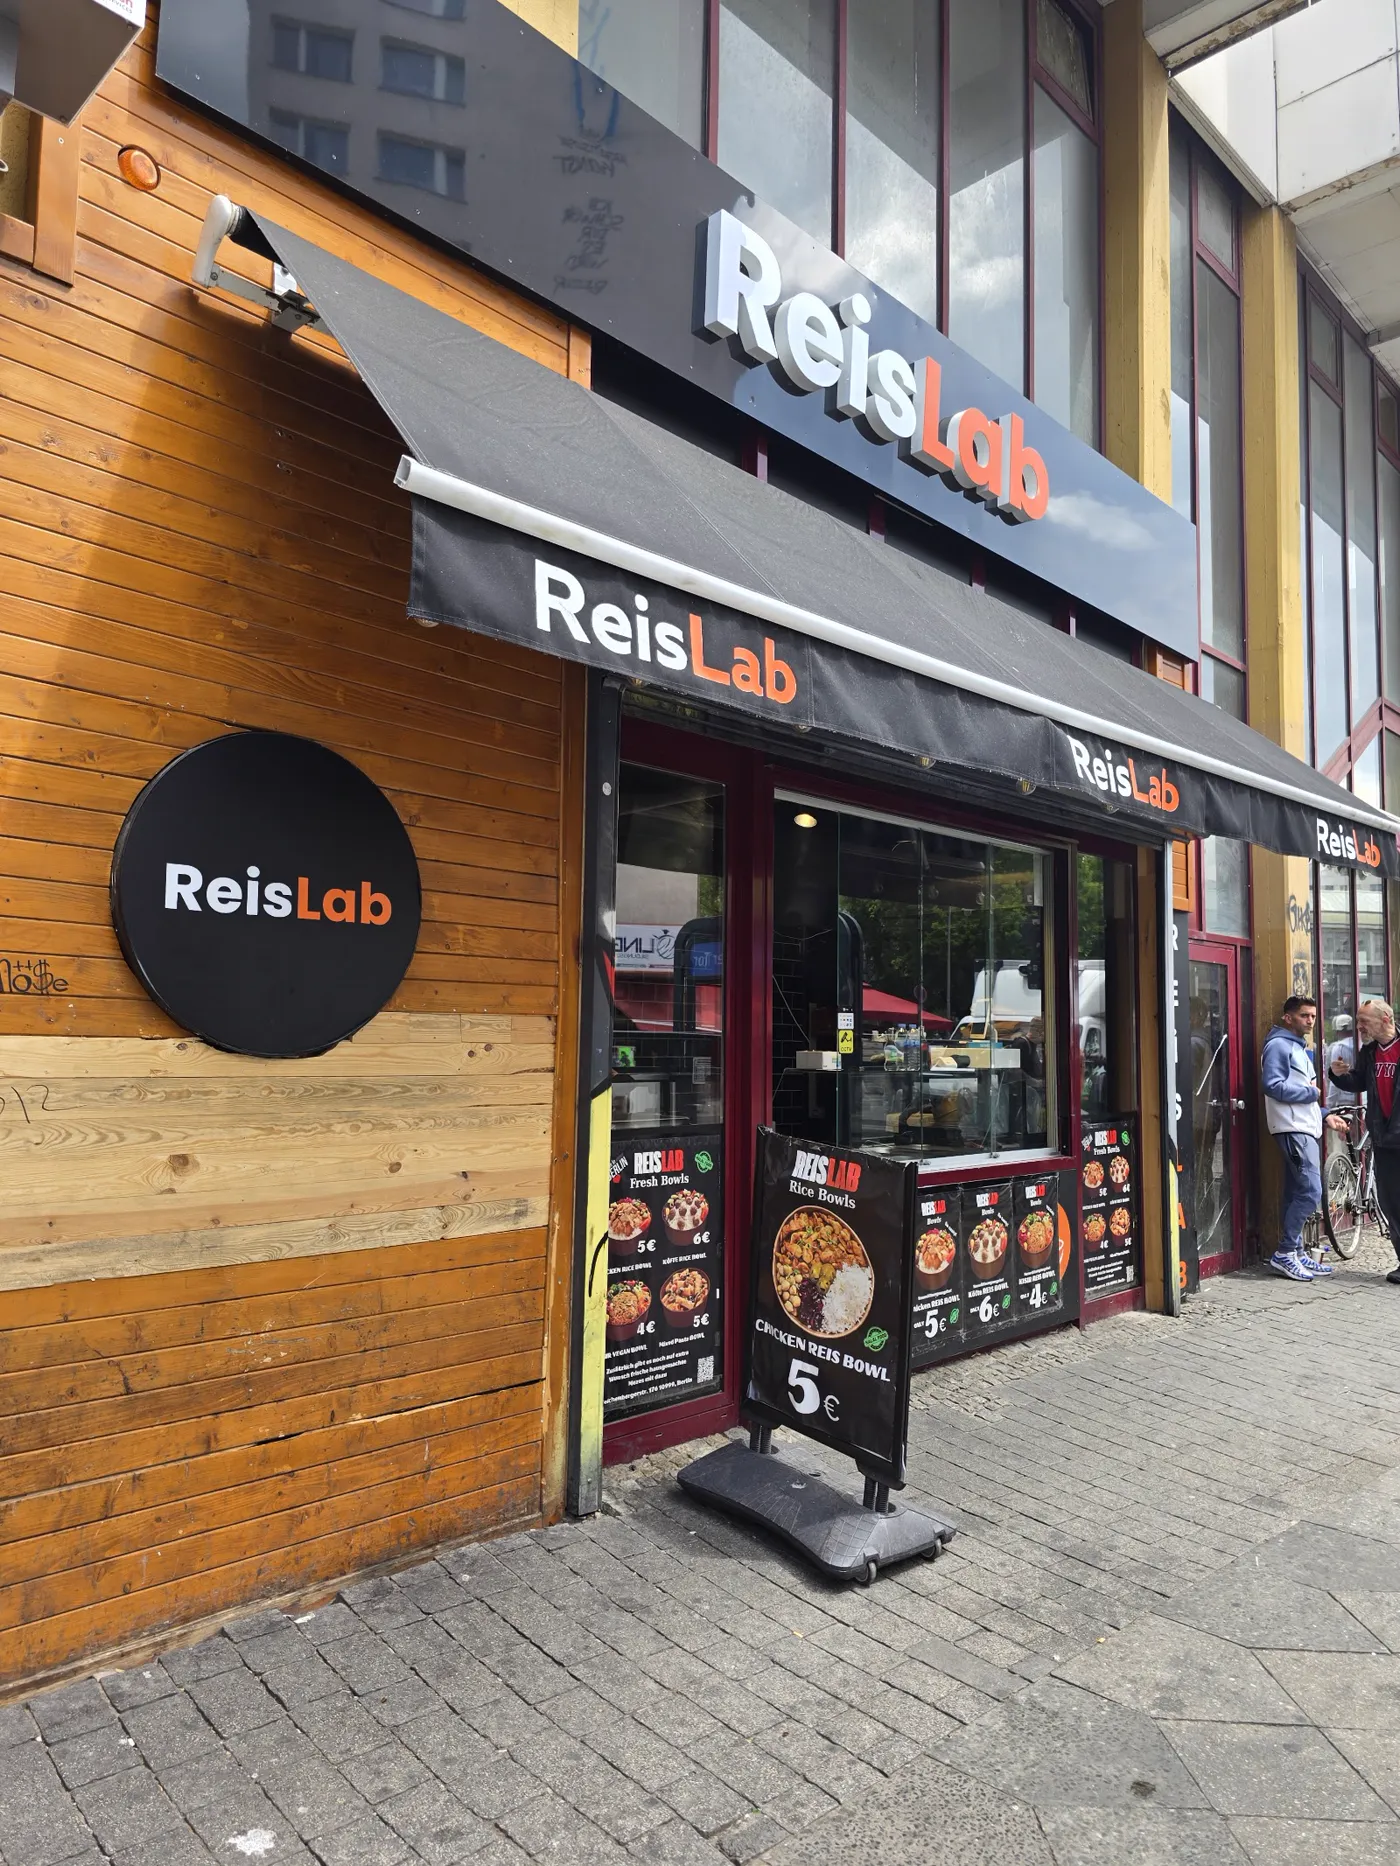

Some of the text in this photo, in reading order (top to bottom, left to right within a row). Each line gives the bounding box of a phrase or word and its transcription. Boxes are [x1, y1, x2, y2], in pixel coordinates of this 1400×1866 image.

[704, 209, 1050, 521] ReisLab
[535, 559, 797, 704] ReisLab
[1067, 735, 1179, 812] ReisLab
[1316, 818, 1381, 867] ReisLab
[165, 863, 392, 925] ReisLab
[634, 1150, 684, 1174] REISLAB
[791, 1149, 862, 1193] REISLAB
[630, 1173, 690, 1189] Fresh Bowls
[789, 1180, 856, 1209] Rice Bowls
[637, 1239, 656, 1253] 5€
[693, 1231, 710, 1244] 6€
[637, 1321, 656, 1335] 4€
[693, 1313, 709, 1327] 5€
[755, 1318, 891, 1382] CHICKEN REIS BOWL
